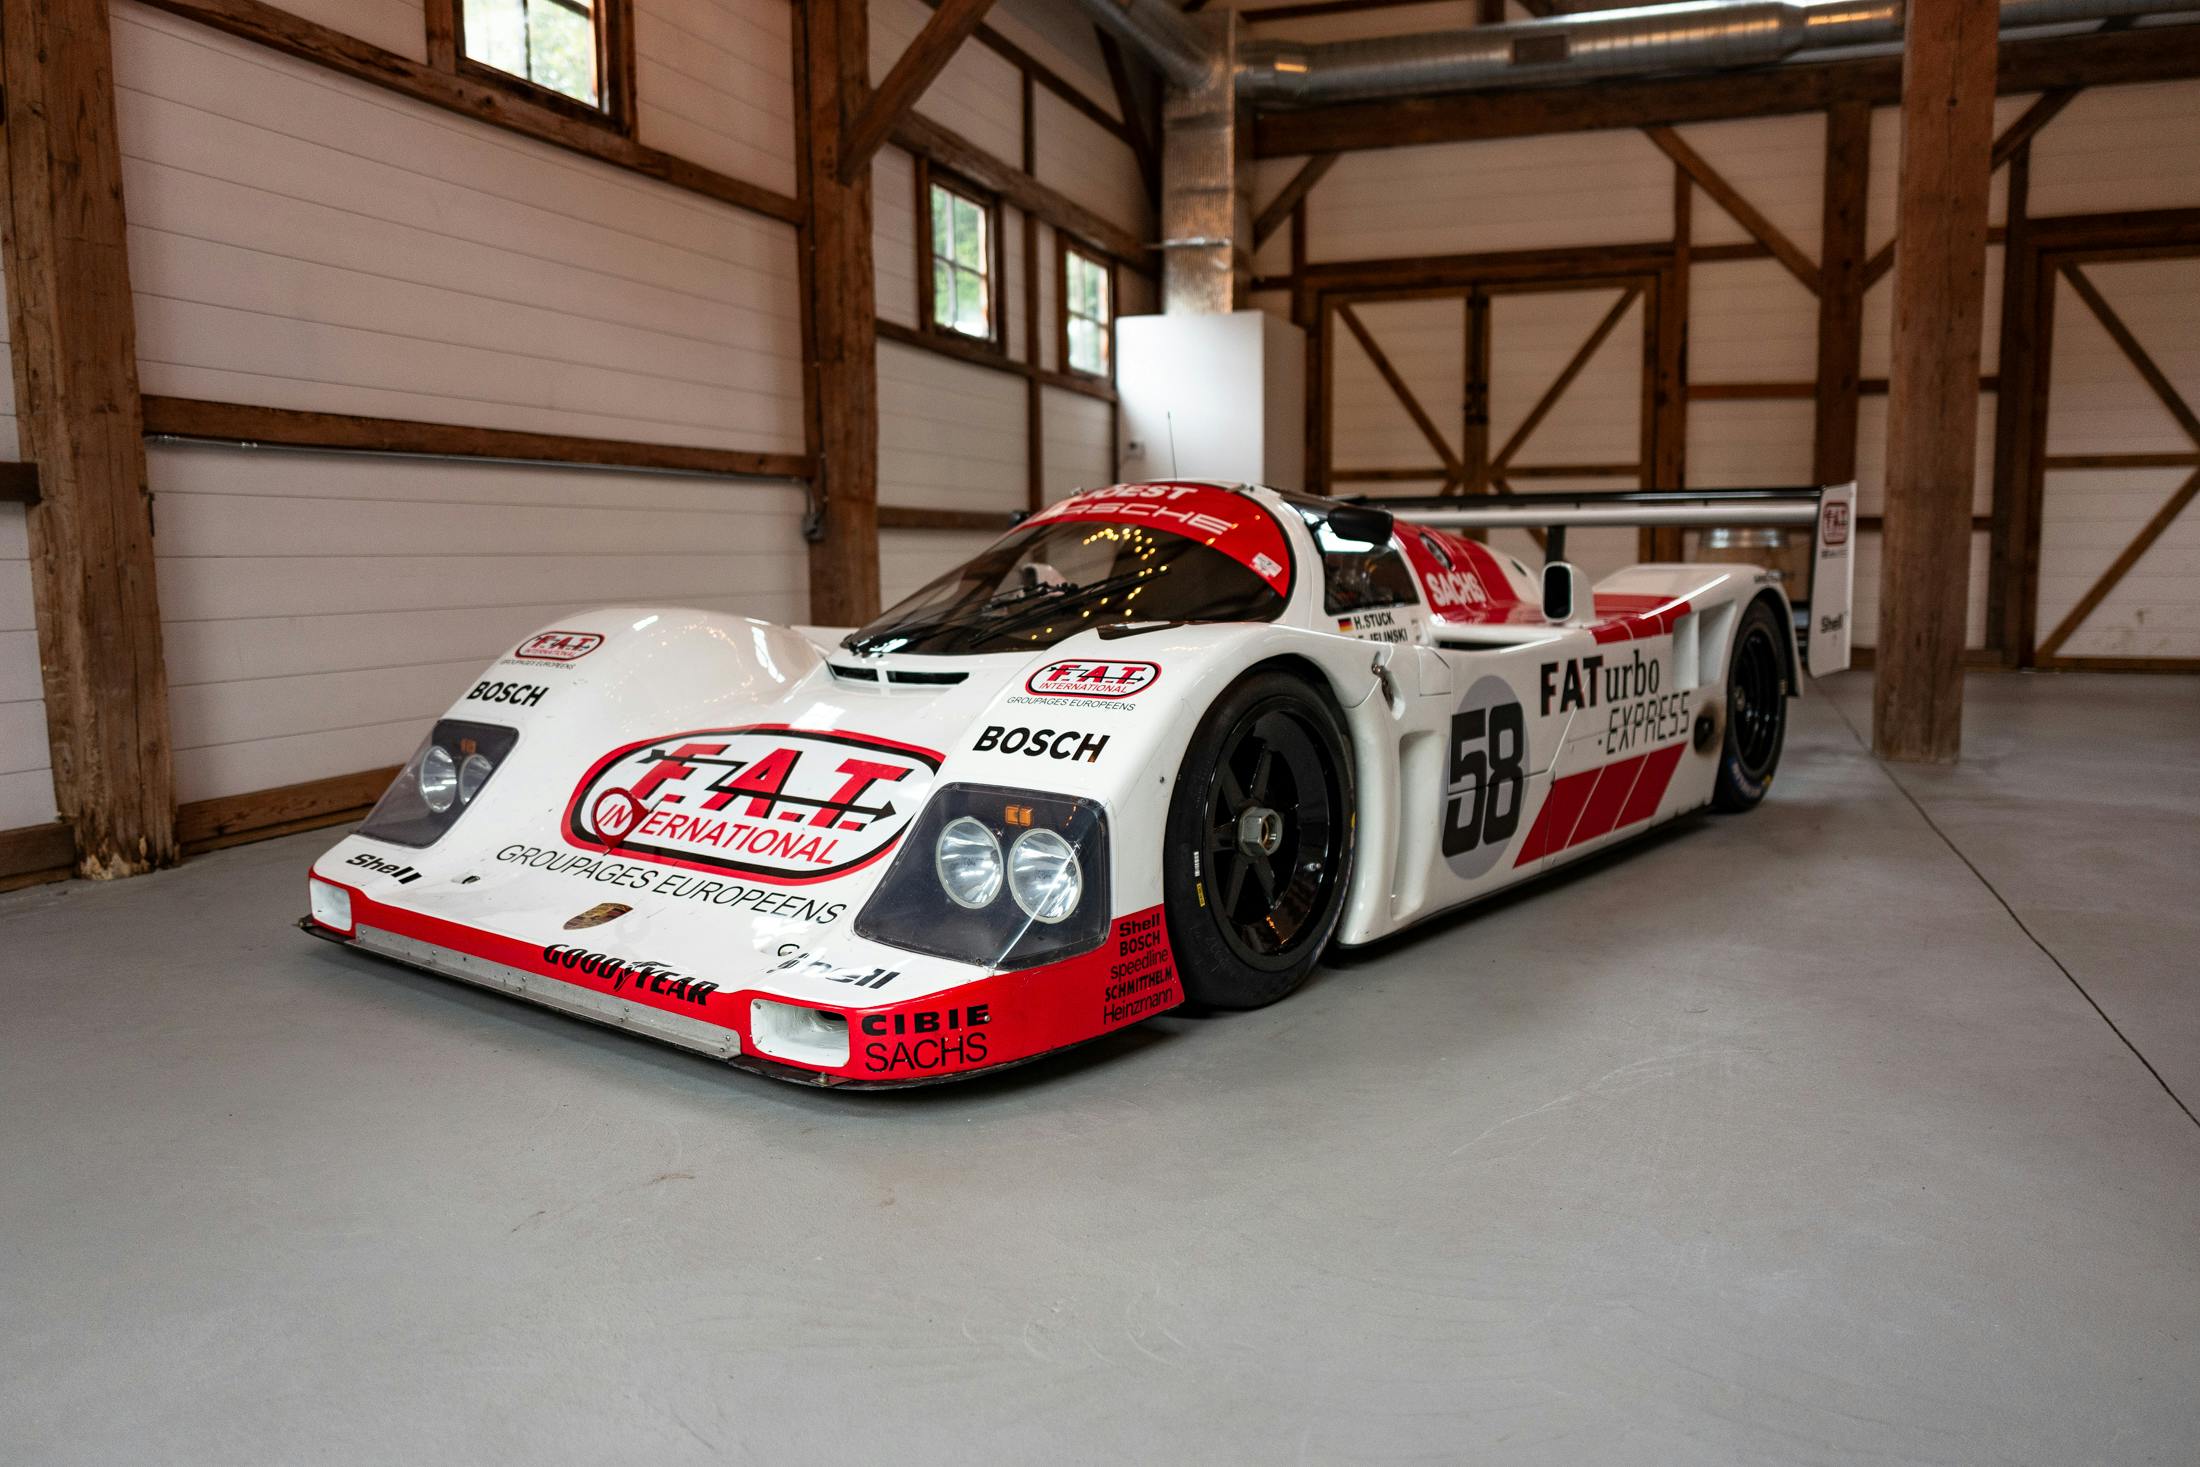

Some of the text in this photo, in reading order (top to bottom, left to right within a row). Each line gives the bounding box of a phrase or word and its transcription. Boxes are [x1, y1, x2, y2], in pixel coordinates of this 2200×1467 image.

[1056, 500, 1232, 536] RSCHE
[1426, 572, 1487, 607] SACHS
[1821, 613, 1844, 634] Shell
[466, 681, 550, 707] BOSCH
[1007, 696, 1136, 711] GROUPAGES EUROPEENS
[1039, 681, 1128, 695] INTERNATIONAL
[1605, 690, 1691, 756] EXPRESS
[972, 725, 1111, 763] BOSCH
[1441, 702, 1525, 858] 58
[597, 802, 841, 866] INERNATIONAL
[346, 853, 423, 885] Shell
[496, 844, 848, 925] GROUPAGES EUROPEENS
[1119, 913, 1161, 938] Shell
[1119, 930, 1161, 957] BOSCH
[1110, 948, 1169, 981] speedline
[1105, 966, 1173, 1002] SCHMITTHELM
[861, 1003, 990, 1037] CIBIE
[1103, 987, 1173, 1025] Heinzmann
[864, 1032, 989, 1073] SACHS
